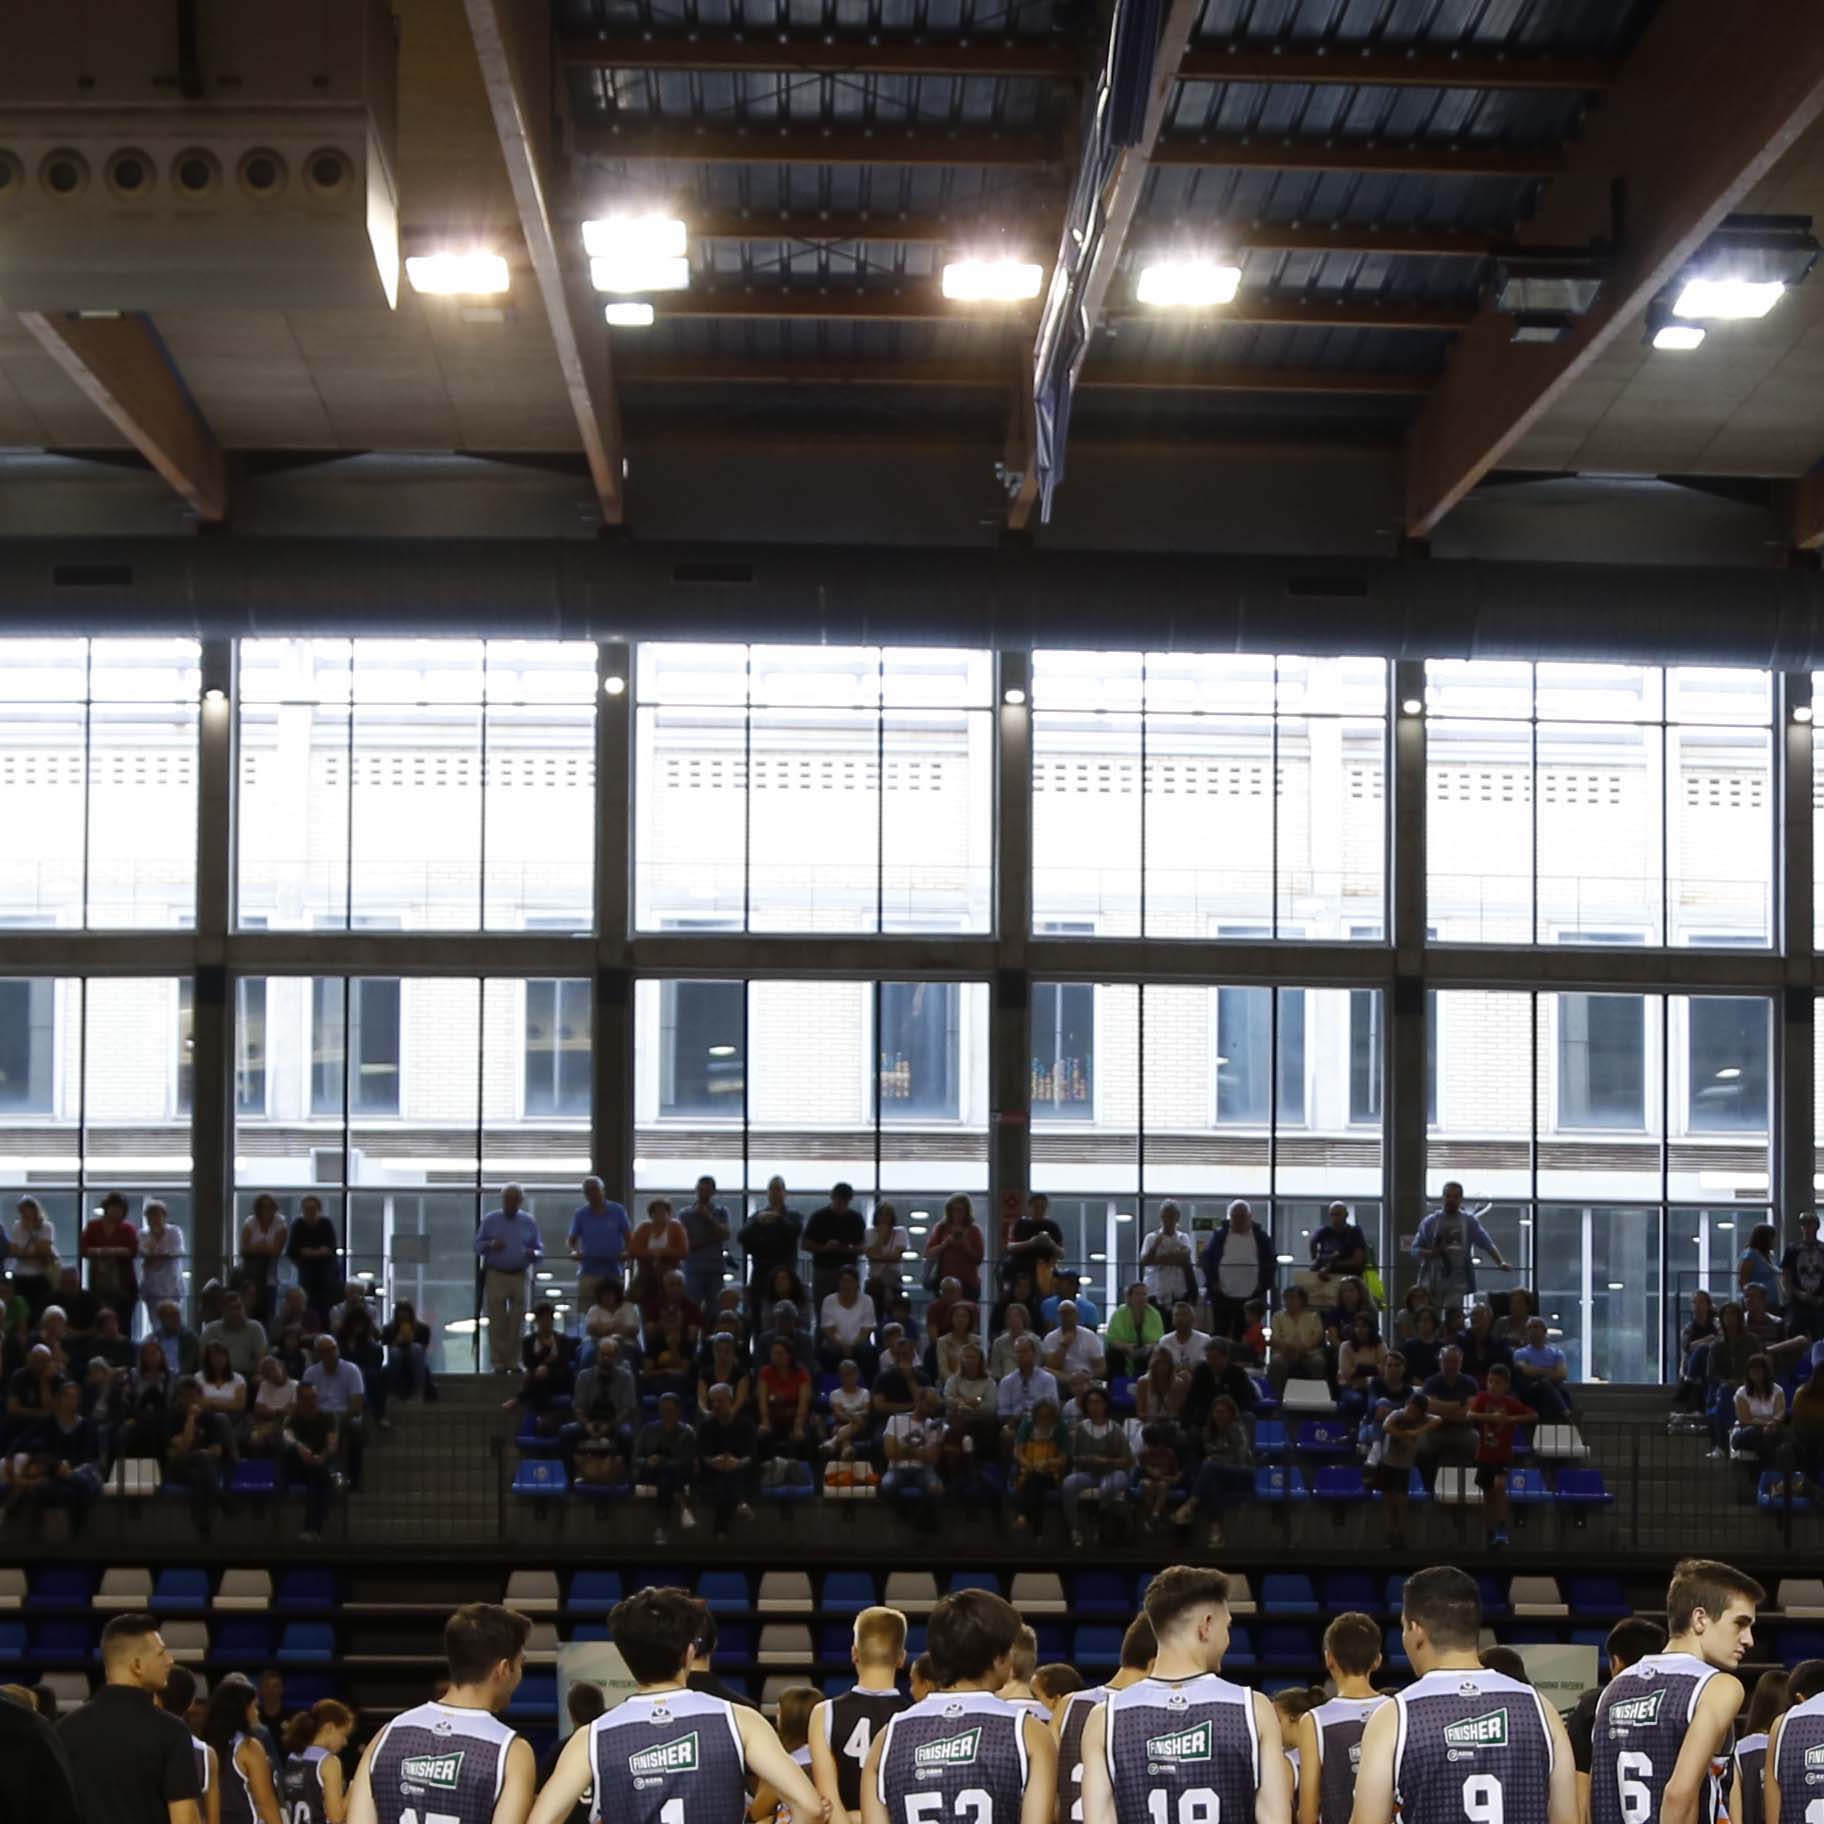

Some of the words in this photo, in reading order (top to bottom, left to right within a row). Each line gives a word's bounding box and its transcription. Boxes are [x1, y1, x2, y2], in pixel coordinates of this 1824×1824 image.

[1448, 1716, 1502, 1741] FINISHER
[634, 1741, 693, 1772] FINISHER
[919, 1736, 973, 1761] FINISHER
[1150, 1730, 1206, 1758] FINISHER
[403, 1758, 459, 1783] FINISHER
